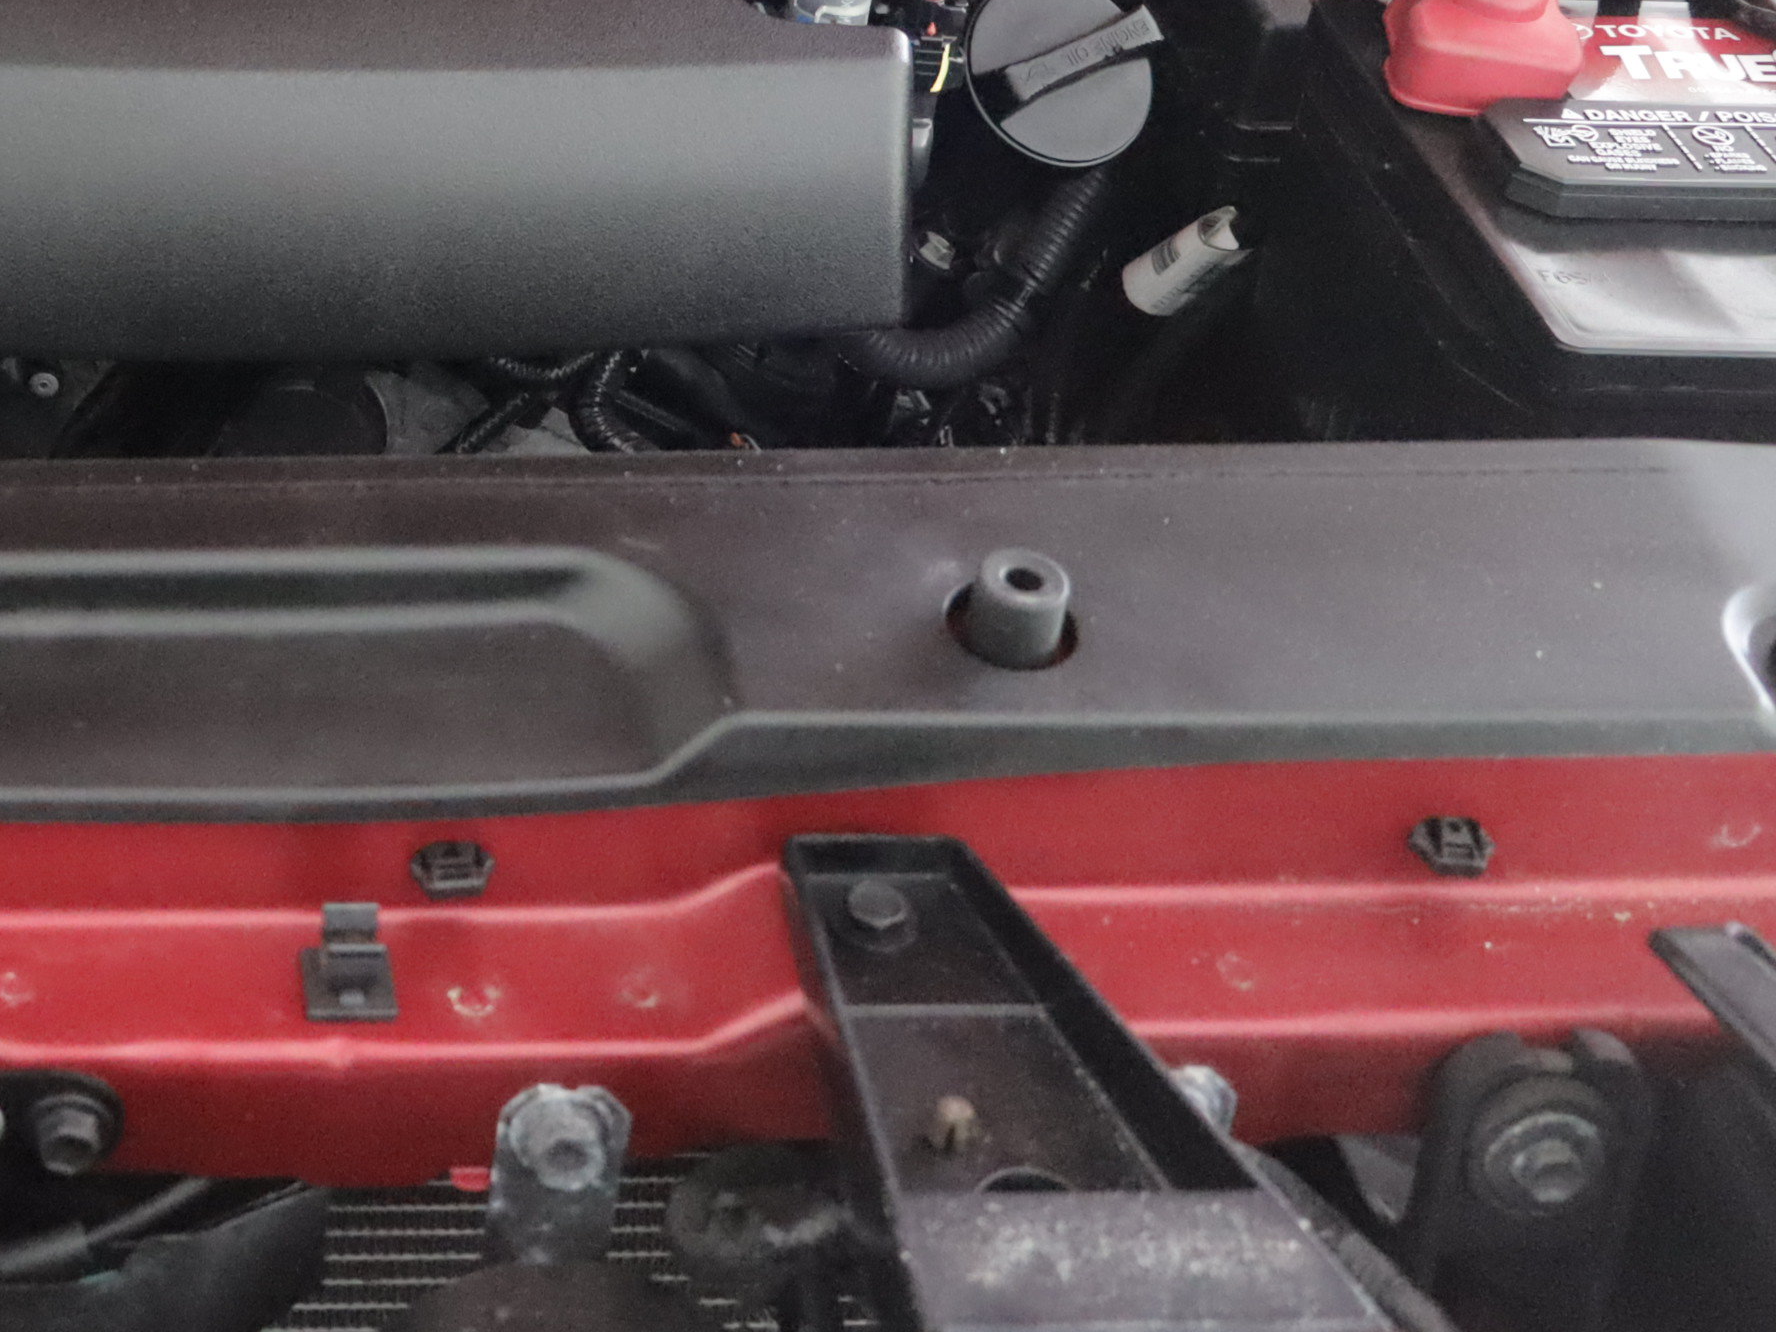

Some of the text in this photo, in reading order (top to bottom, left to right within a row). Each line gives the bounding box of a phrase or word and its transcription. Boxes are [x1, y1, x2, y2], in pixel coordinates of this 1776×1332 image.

[1594, 23, 1742, 42] TOYOTA
[1599, 45, 1776, 84] TRUE
[1583, 110, 1694, 123] DANGER
[1714, 112, 1776, 123] POIS
